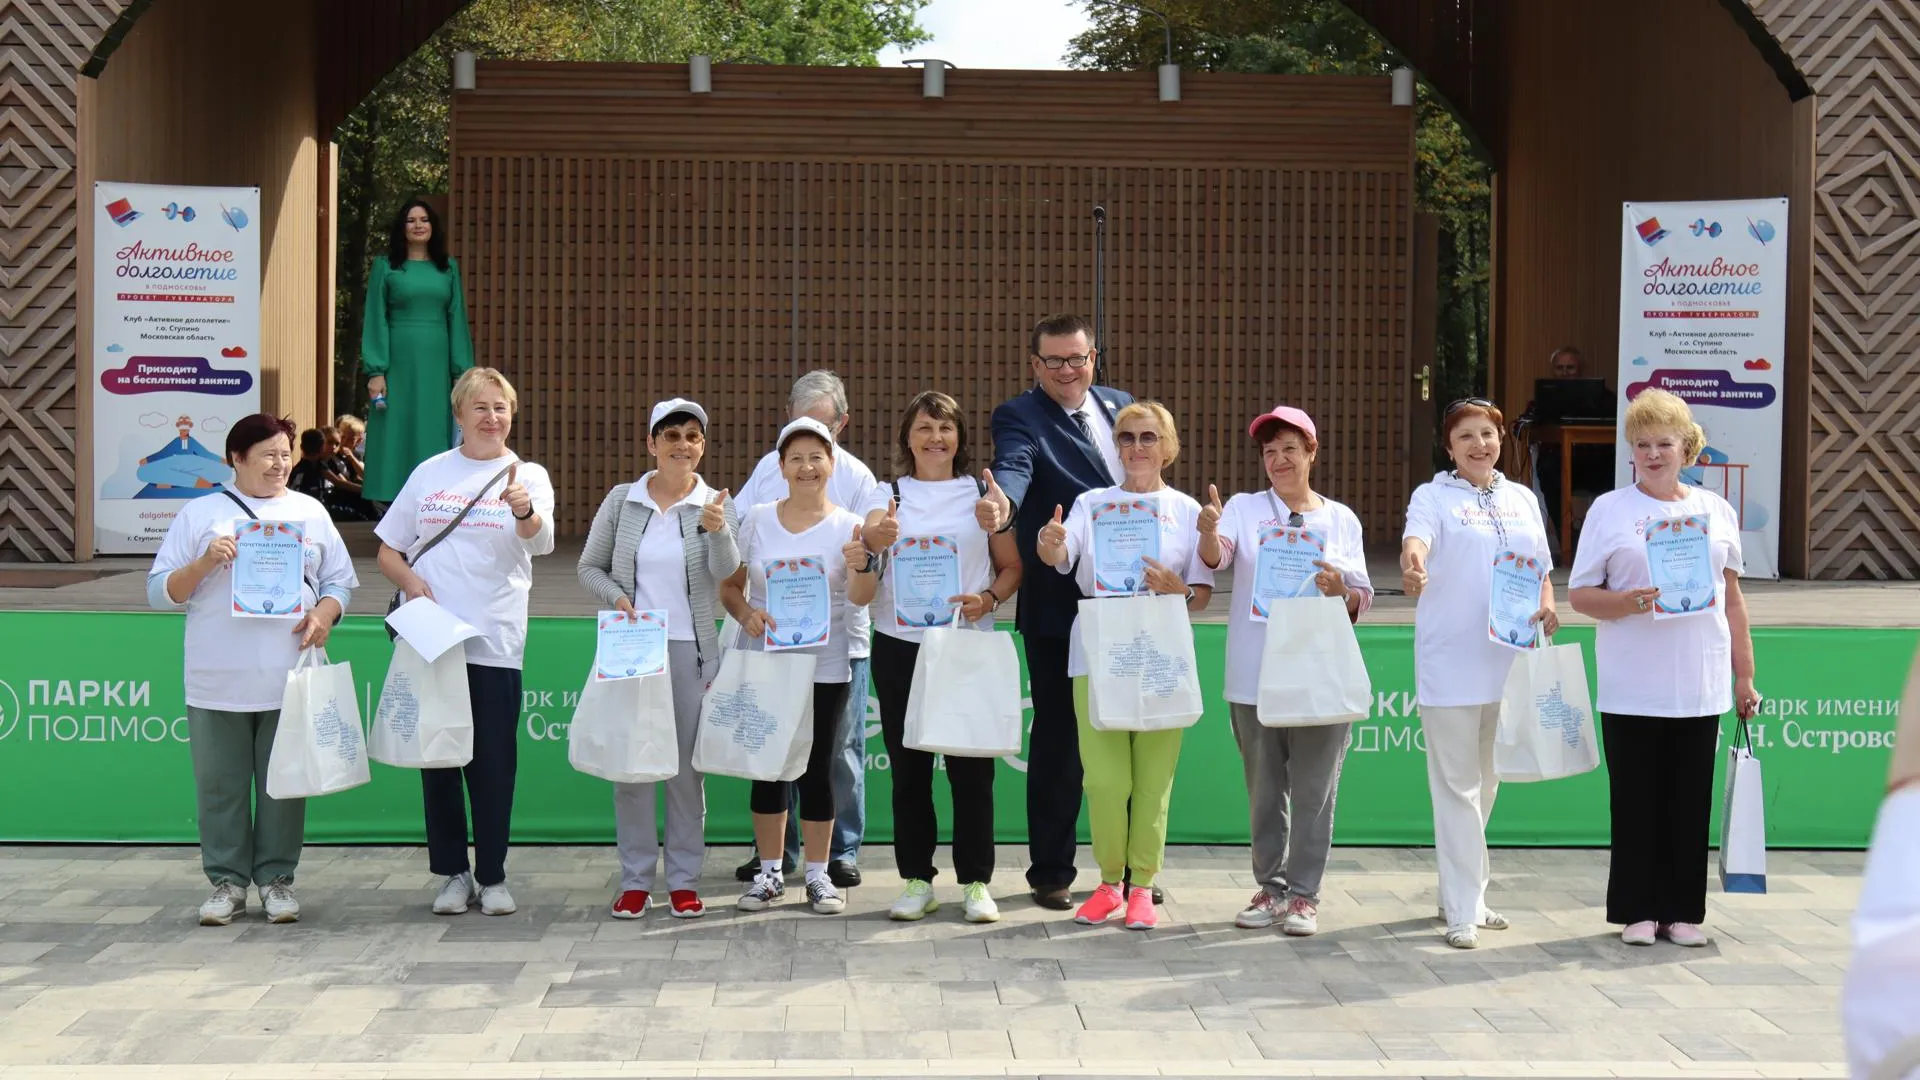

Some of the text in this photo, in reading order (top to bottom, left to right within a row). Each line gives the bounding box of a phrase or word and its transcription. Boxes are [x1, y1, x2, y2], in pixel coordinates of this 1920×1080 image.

[116, 240, 234, 262] Активное
[116, 258, 238, 280] долголетие
[1644, 256, 1760, 277] Активное
[1643, 276, 1762, 295] долголетие
[1709, 348, 1737, 356] область
[138, 364, 198, 374] Приходите
[133, 375, 197, 385] бесплатные
[199, 377, 241, 386] занятия
[1661, 377, 1719, 388] Приходите
[1720, 390, 1763, 399] занятия
[425, 490, 506, 507] Актиное
[421, 502, 506, 517] долгоетие
[28, 680, 150, 707] ПАРКИ
[1757, 698, 1900, 720] арк имени
[28, 715, 191, 742] ПОДМОС
